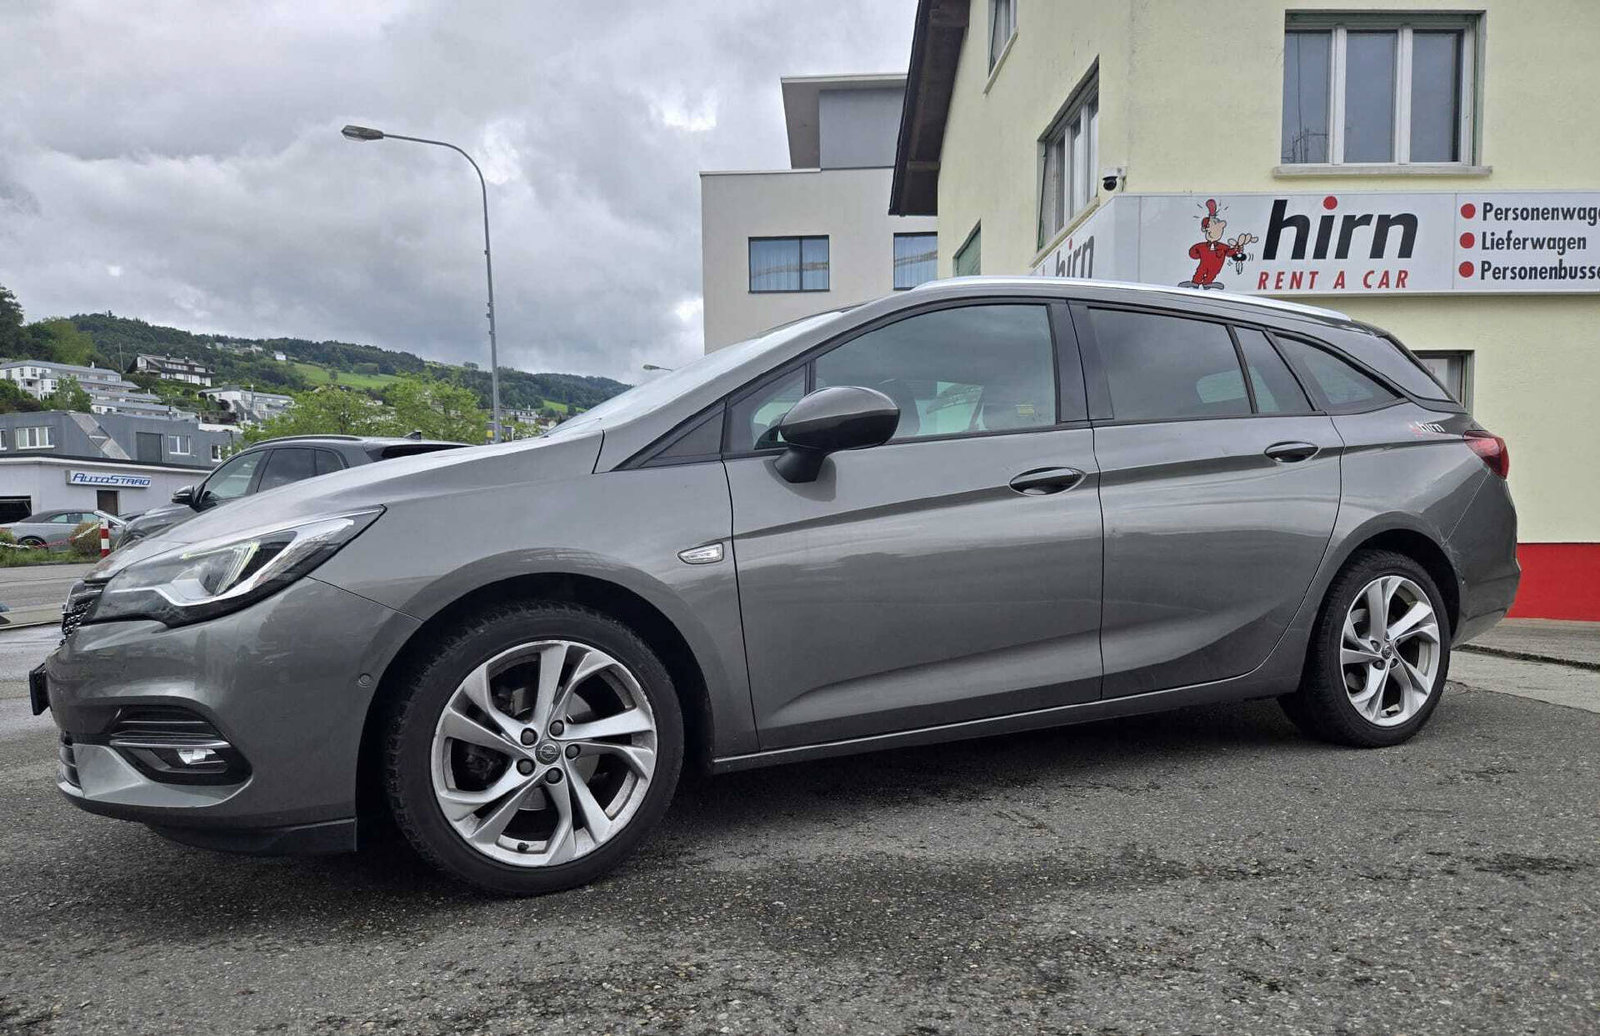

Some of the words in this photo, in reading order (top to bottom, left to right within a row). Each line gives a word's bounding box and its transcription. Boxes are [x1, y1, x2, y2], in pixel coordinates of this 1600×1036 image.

[1482, 202, 1600, 226] Personenwag
[1262, 196, 1418, 260] hirn
[1481, 230, 1587, 256] Lieferwagen
[1055, 235, 1095, 279] hirn
[1257, 271, 1319, 290] RENT
[1332, 270, 1346, 290] A
[1362, 270, 1409, 289] CAR
